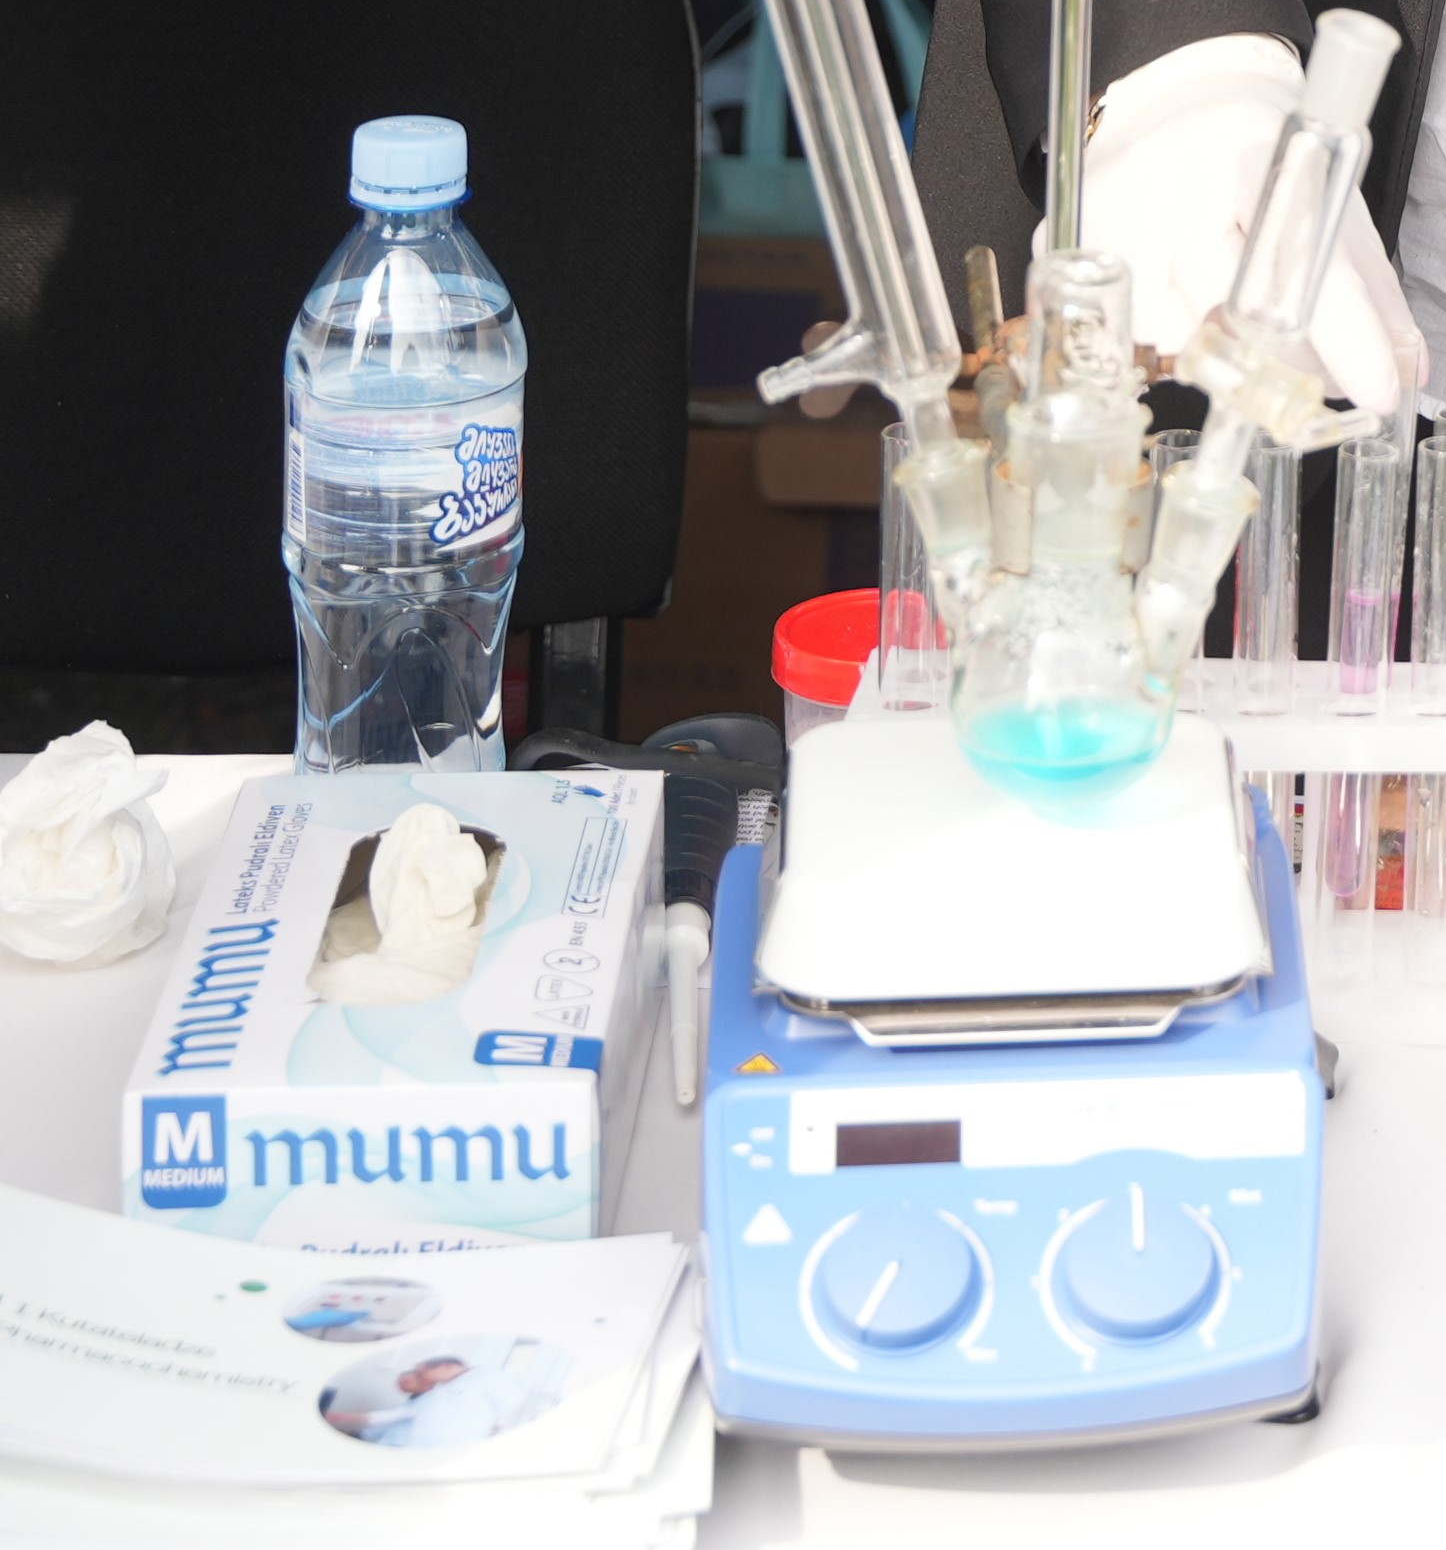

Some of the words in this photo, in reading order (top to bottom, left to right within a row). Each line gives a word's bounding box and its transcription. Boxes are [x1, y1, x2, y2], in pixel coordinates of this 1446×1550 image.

[254, 804, 286, 841] Eldiven
[253, 858, 290, 913] Powdered
[283, 802, 313, 834] Gloves
[156, 918, 280, 1076] mumu
[490, 1034, 549, 1063] M
[154, 1111, 213, 1164] M
[245, 1122, 571, 1187] mumu
[143, 1166, 225, 1188] MEDIUM
